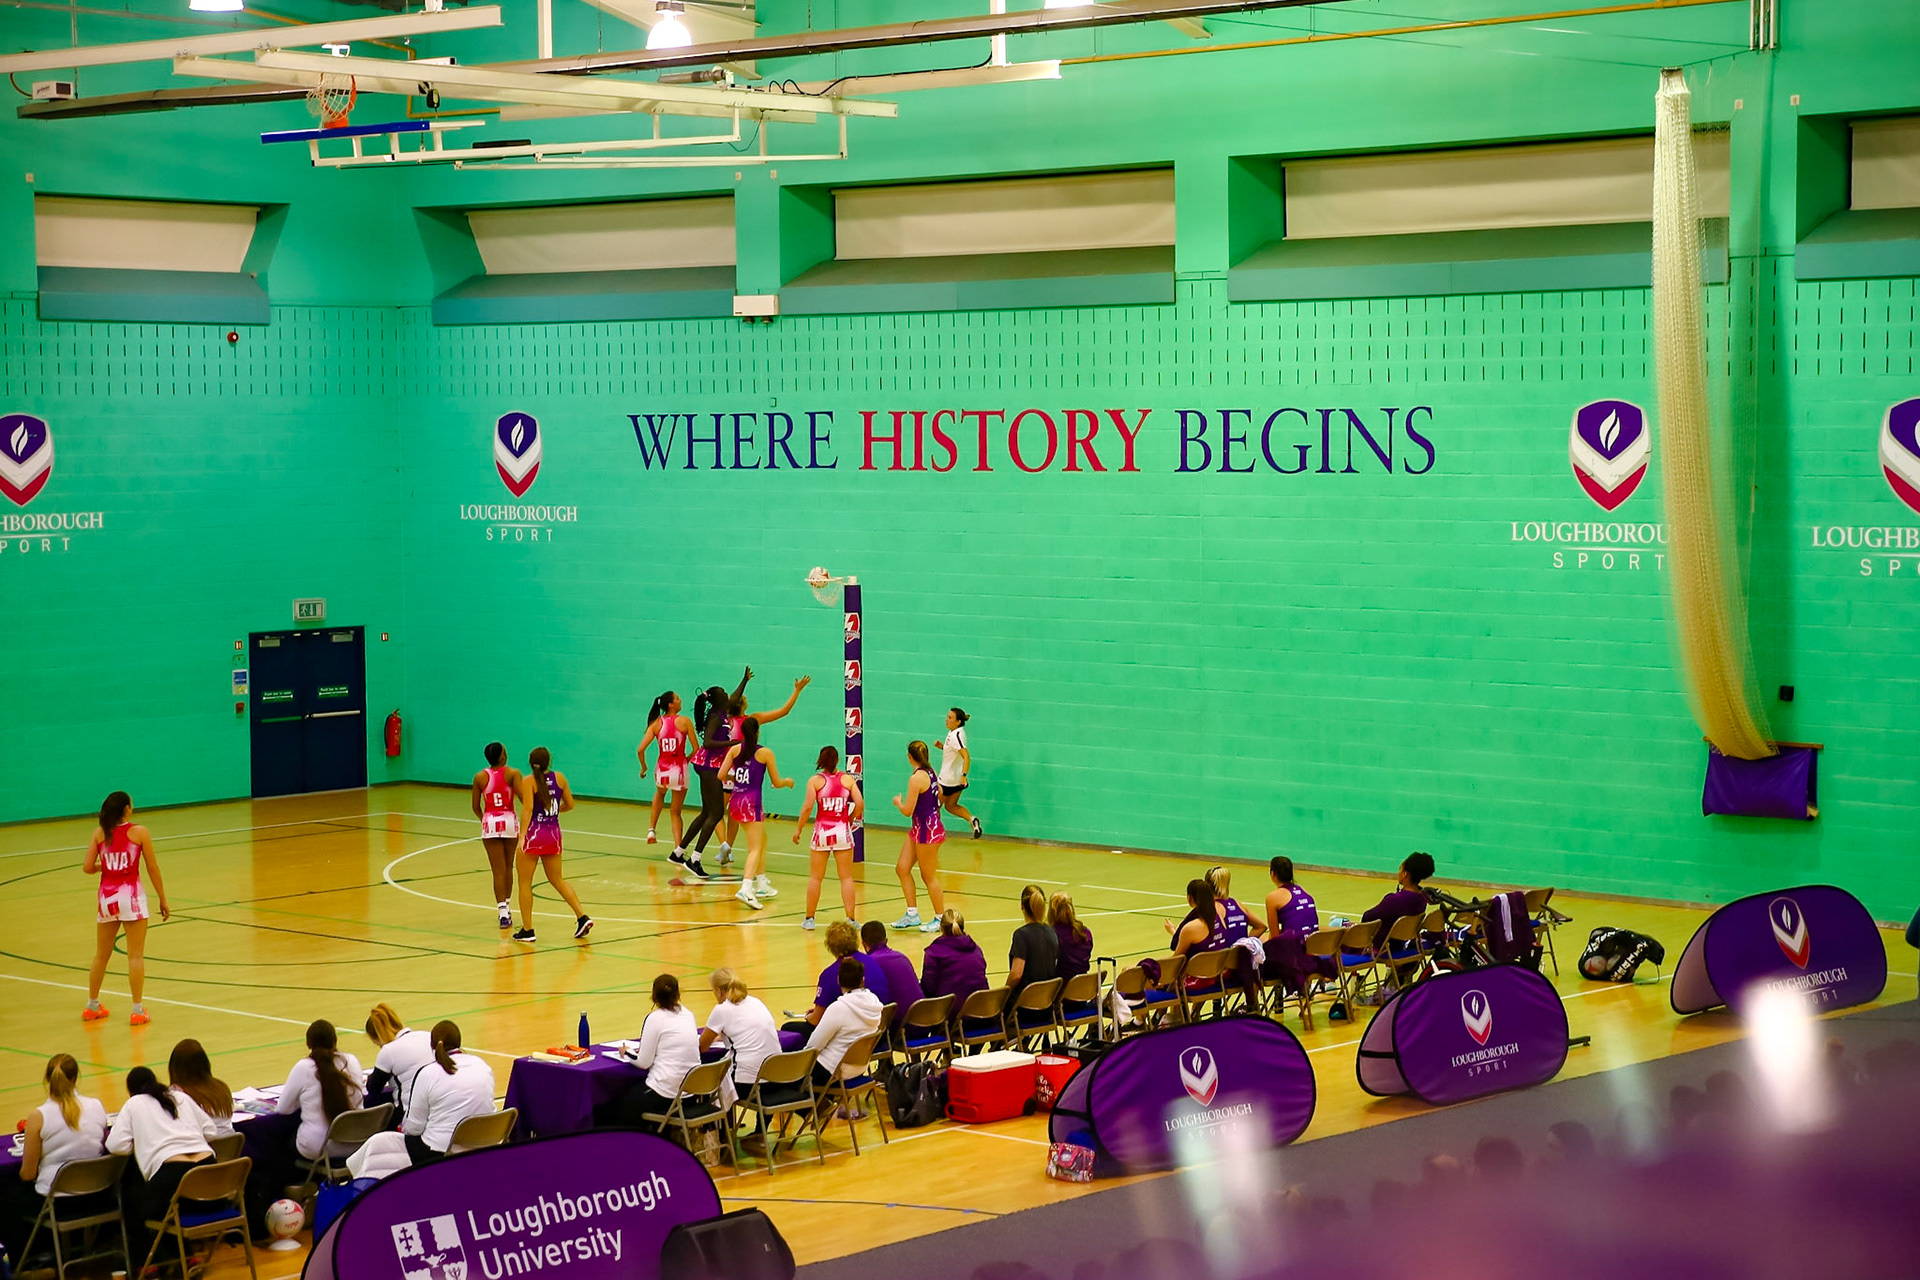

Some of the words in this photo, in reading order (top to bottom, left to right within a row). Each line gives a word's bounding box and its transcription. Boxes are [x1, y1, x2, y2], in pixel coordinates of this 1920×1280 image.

[626, 410, 838, 471] WHERE
[857, 407, 1153, 473] HISTORY
[1173, 406, 1436, 474] BEGINS
[460, 504, 578, 522] LOUGHBOROUGH
[486, 527, 552, 541] SPORT
[1511, 521, 1671, 544] LOUGHBOROU
[1552, 551, 1665, 571] SPORT
[1860, 558, 1920, 577] SP
[661, 738, 677, 752] GD
[735, 767, 750, 784] GA
[104, 851, 129, 871] WA
[1767, 967, 1849, 993] LOUGHBOROUGH
[1451, 1042, 1519, 1068] LOUGHBOROUGH
[1468, 1060, 1507, 1077] SPORT
[1165, 1103, 1253, 1132] LOUGHBOROUGH
[467, 1170, 672, 1241] Loughborough
[478, 1227, 623, 1280] University
